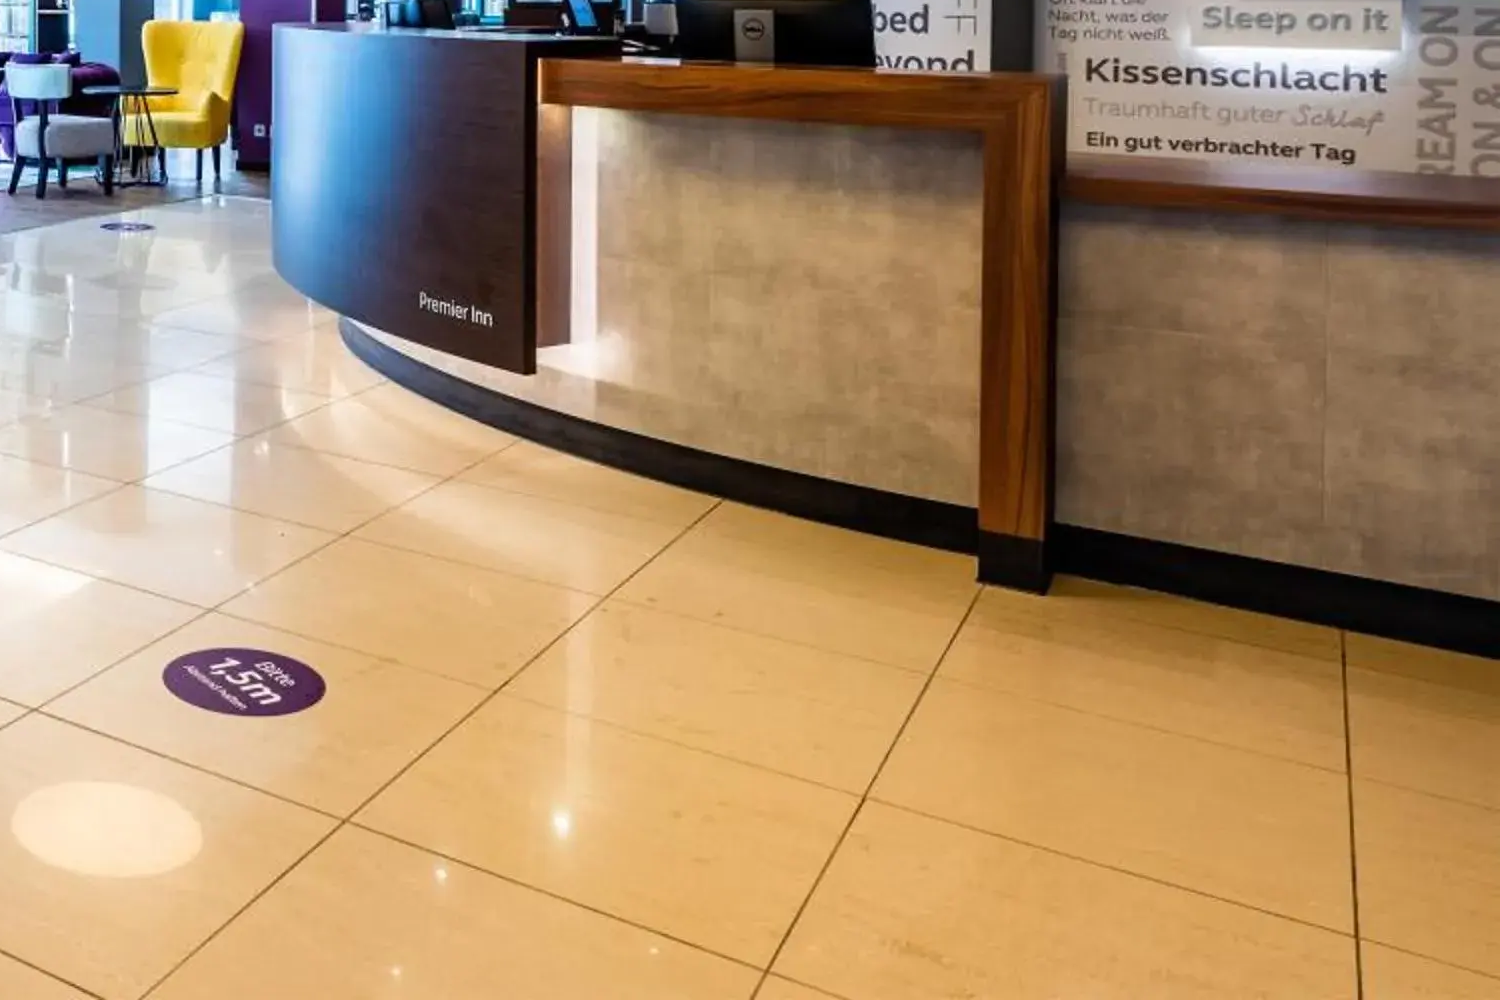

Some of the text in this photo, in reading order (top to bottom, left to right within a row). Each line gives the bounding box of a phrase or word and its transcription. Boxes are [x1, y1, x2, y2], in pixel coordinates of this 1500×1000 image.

[872, 3, 930, 34] bed
[1050, 26, 1077, 42] Tag
[1083, 27, 1124, 40] nicht
[1105, 13, 1138, 23] was
[1141, 11, 1169, 23] der
[1203, 6, 1389, 35] Sleep on it
[1418, 6, 1459, 67] ON
[1085, 57, 1388, 94] Kissenschlacht
[1084, 97, 1385, 136] Traumhaft guter Schlaf
[1086, 131, 1356, 165] Ein gut verbrachter Tag
[419, 291, 494, 328] Premier Inn
[209, 657, 282, 705] 1,5m
